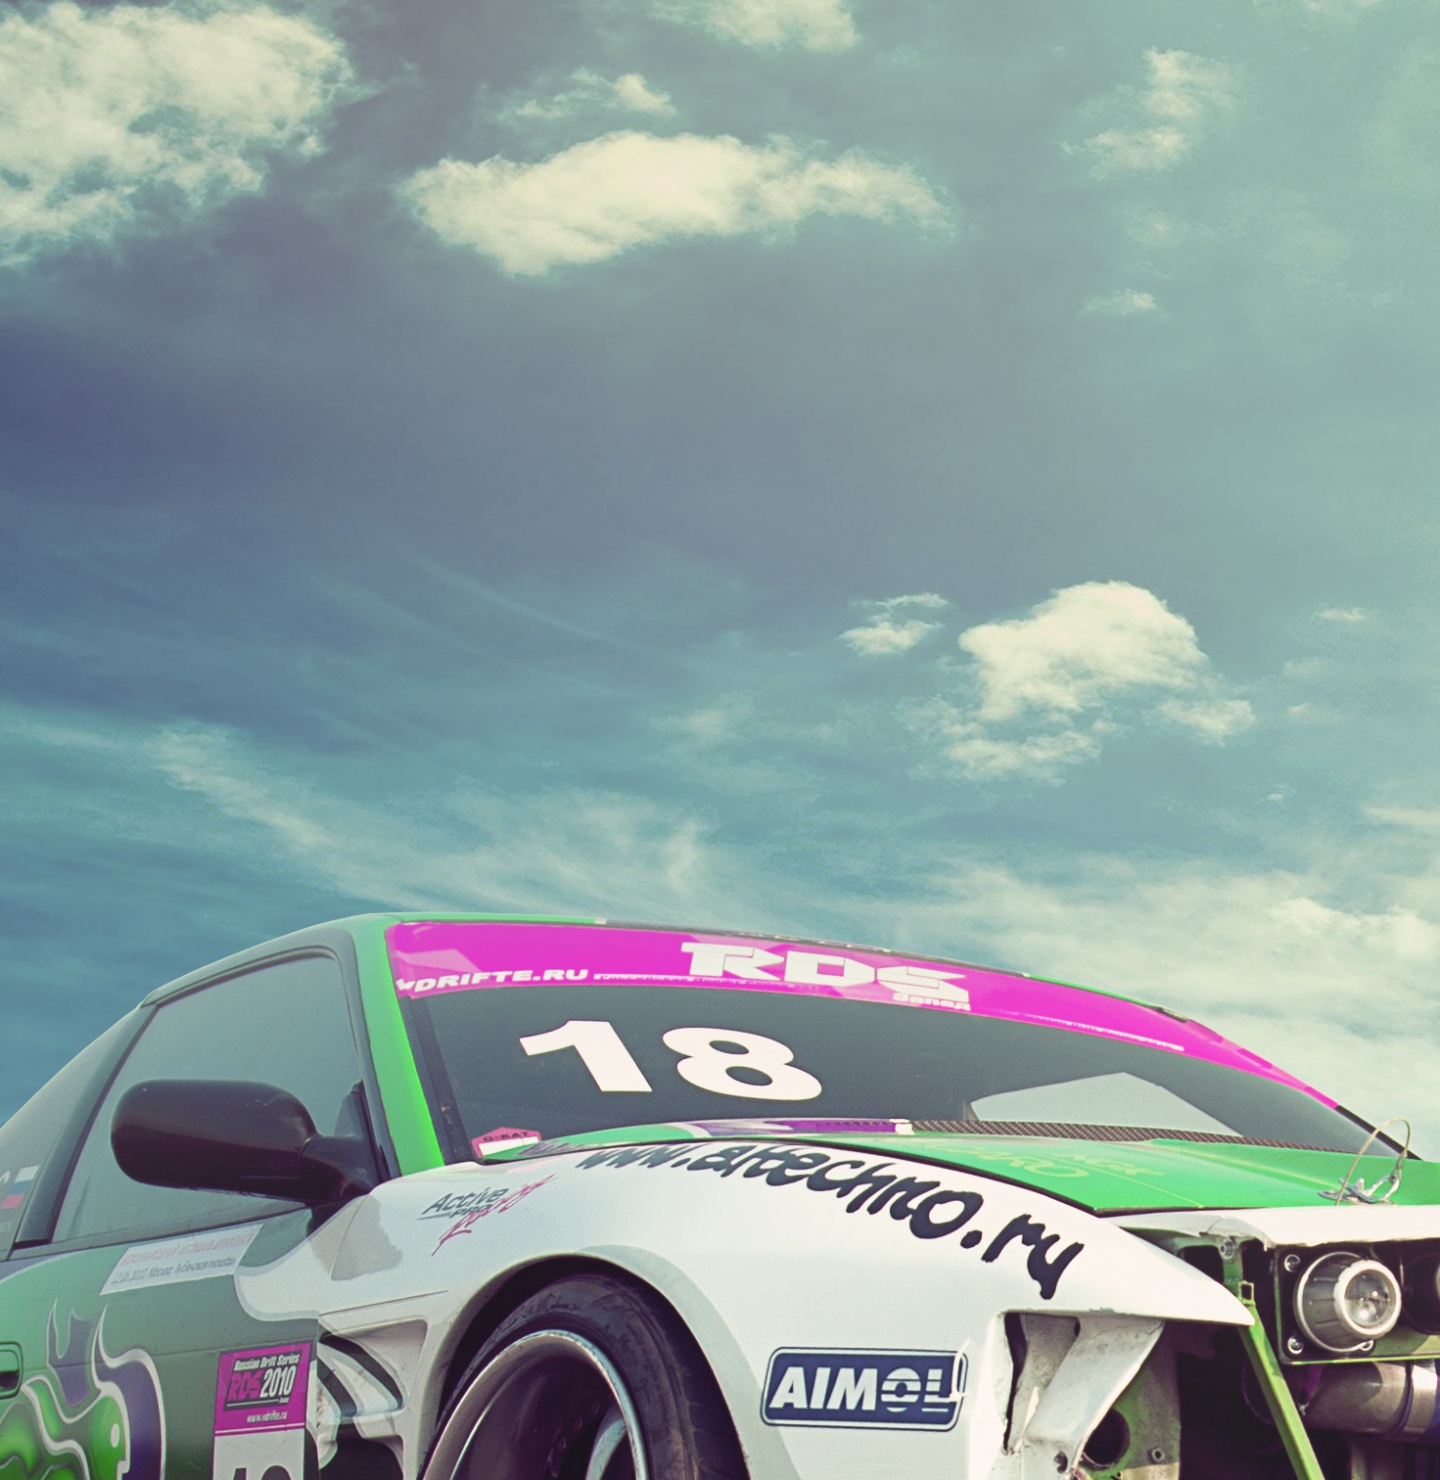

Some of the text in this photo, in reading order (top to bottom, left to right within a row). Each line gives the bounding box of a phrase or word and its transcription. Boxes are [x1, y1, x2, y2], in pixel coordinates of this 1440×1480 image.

[681, 942, 970, 1003] RDS
[518, 1020, 823, 1101] 18
[228, 1366, 297, 1401] RDS 2010
[260, 1355, 278, 1369] Drift
[277, 1354, 300, 1367] Series
[768, 1366, 957, 1413] AIMOL
